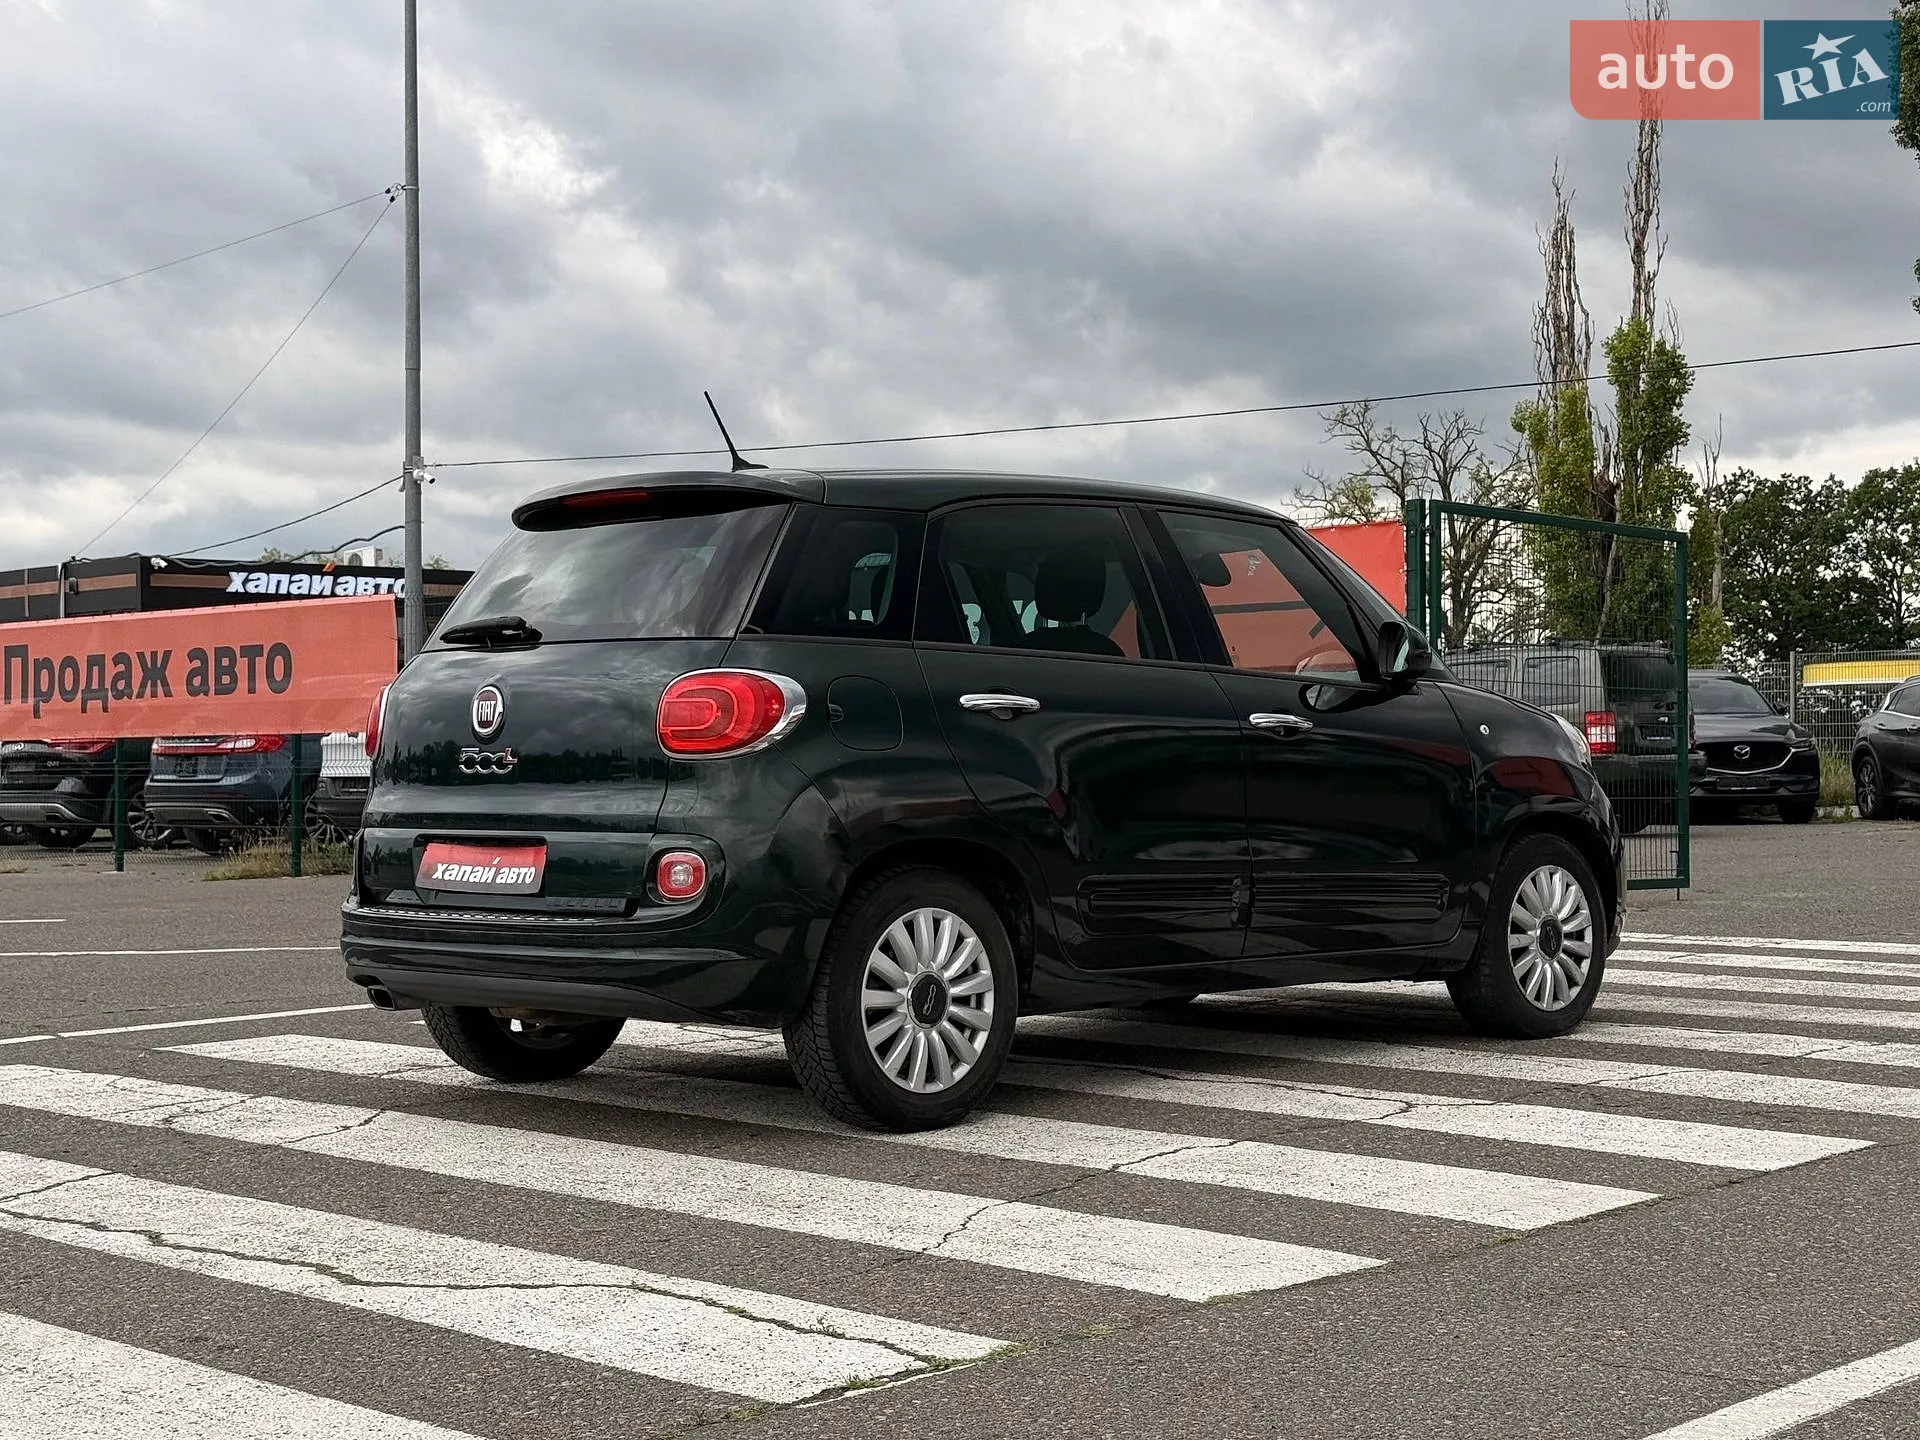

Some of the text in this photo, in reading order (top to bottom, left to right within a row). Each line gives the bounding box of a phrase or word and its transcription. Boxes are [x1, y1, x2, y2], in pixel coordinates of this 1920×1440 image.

[4, 642, 293, 719] Продаж авто
[478, 700, 497, 721] FIAT
